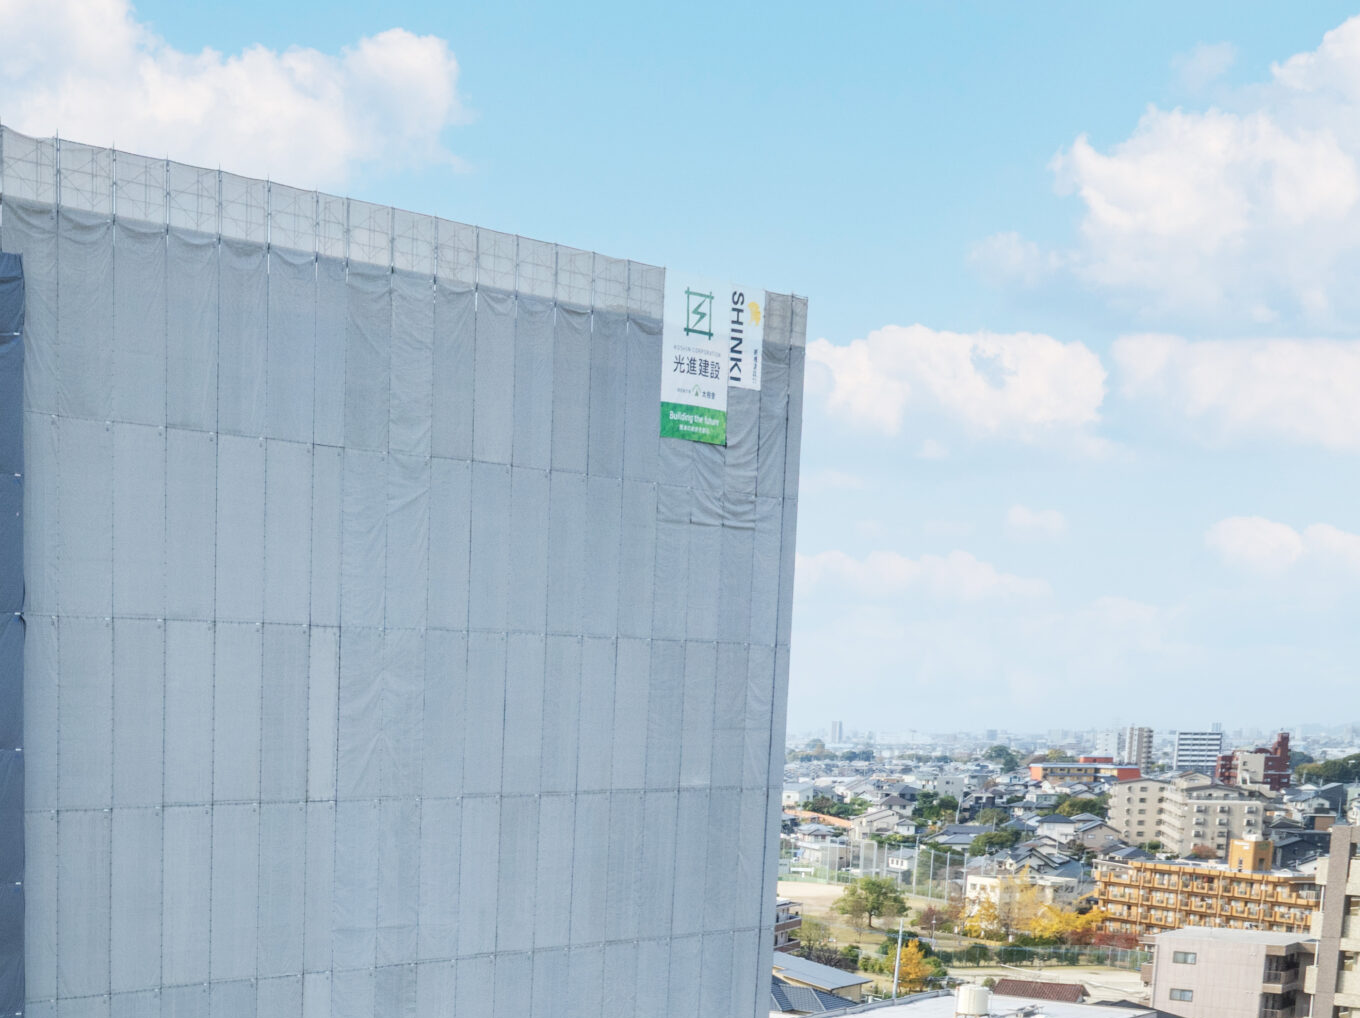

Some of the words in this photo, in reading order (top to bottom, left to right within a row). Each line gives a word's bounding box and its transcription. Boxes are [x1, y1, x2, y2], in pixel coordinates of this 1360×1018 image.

[729, 290, 745, 382] SHINKI
[673, 354, 721, 380] 光進建設
[669, 410, 693, 424] Building
